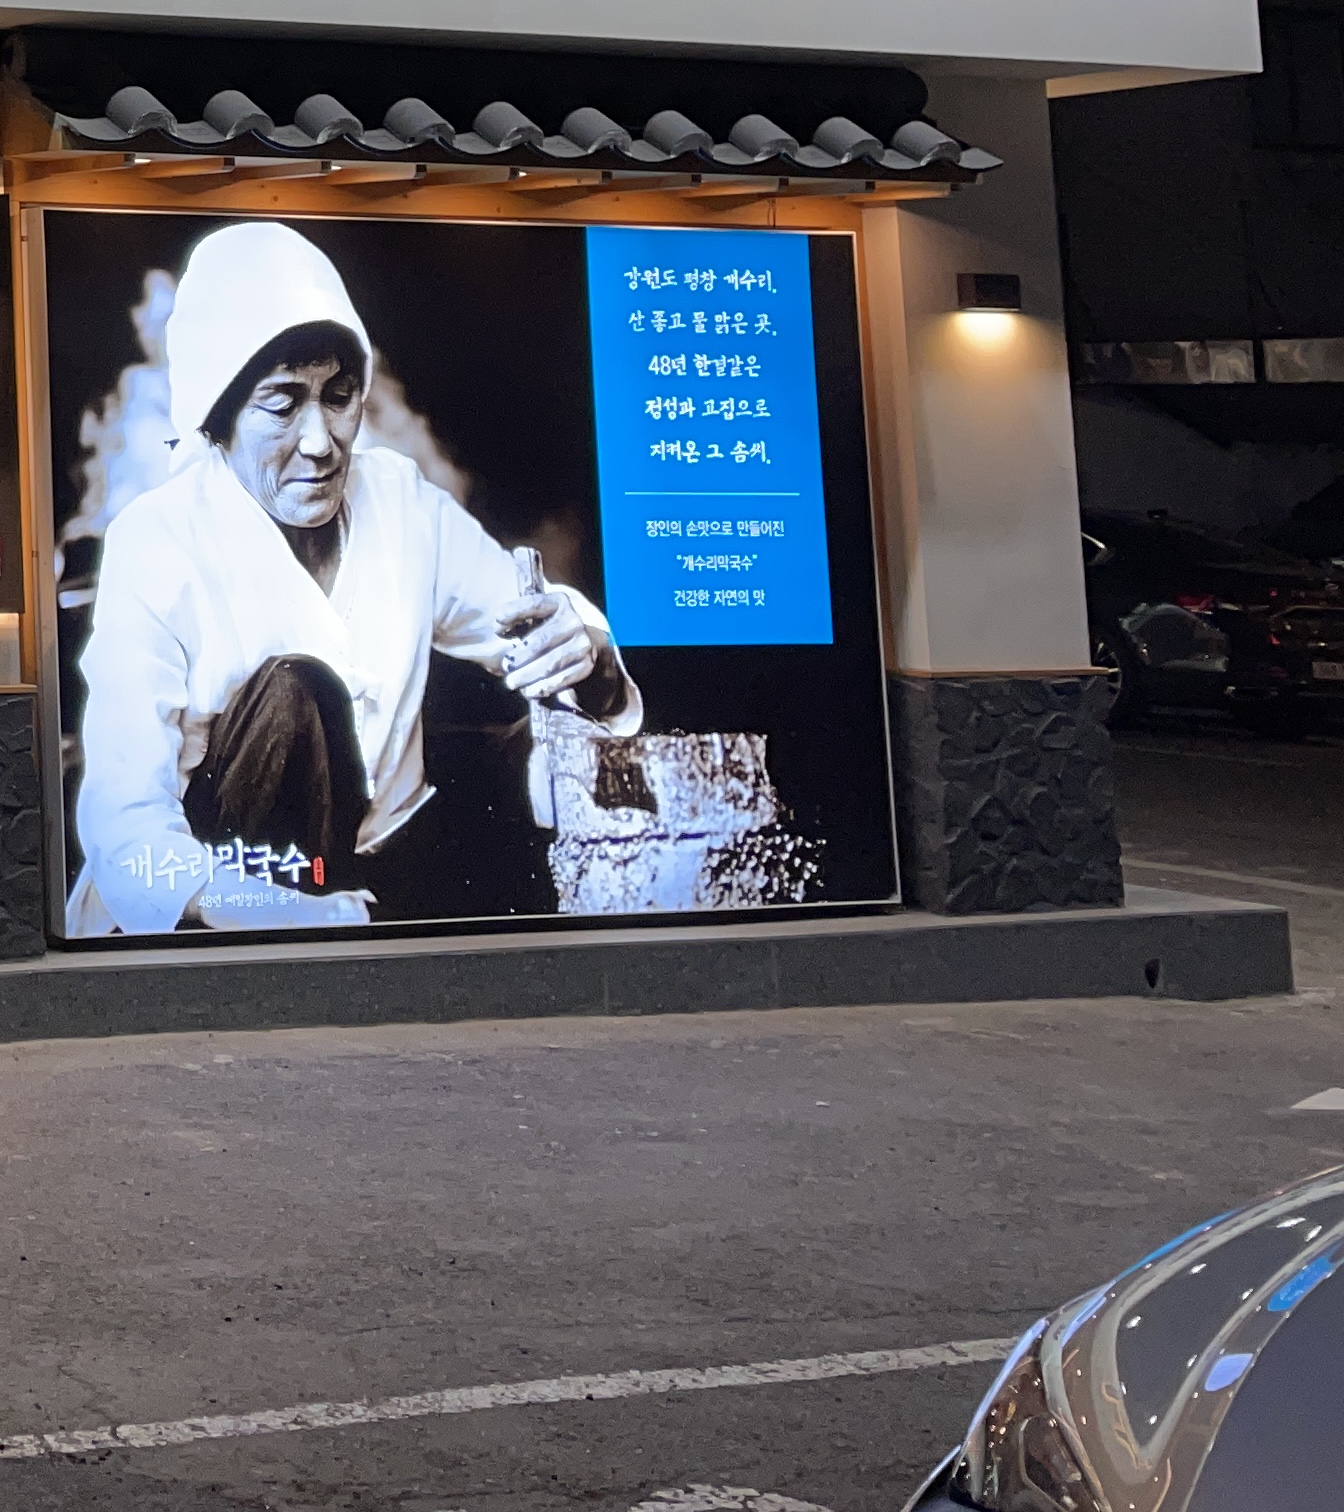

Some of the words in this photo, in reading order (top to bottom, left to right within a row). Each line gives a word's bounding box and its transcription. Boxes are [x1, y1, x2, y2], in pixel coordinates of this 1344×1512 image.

[623, 266, 678, 291] 강원도
[683, 268, 718, 292] 평창
[628, 311, 646, 333] 산
[650, 311, 687, 333] 좋고
[692, 312, 709, 334] 물
[714, 312, 750, 335] 맑은
[648, 354, 687, 377] 48년
[694, 354, 762, 377] 한결같은
[644, 397, 696, 420] 정성과
[701, 398, 772, 421] 고집으로
[650, 441, 702, 463] 지켜온
[706, 442, 725, 460] 그
[645, 520, 683, 538] 장인의
[685, 520, 735, 538] 손맛으로
[737, 520, 786, 539] 만들어진
[673, 590, 711, 608] 건강한
[713, 590, 750, 608] 자연의
[752, 589, 766, 608] 맛
[120, 836, 312, 891] 개수리막국수
